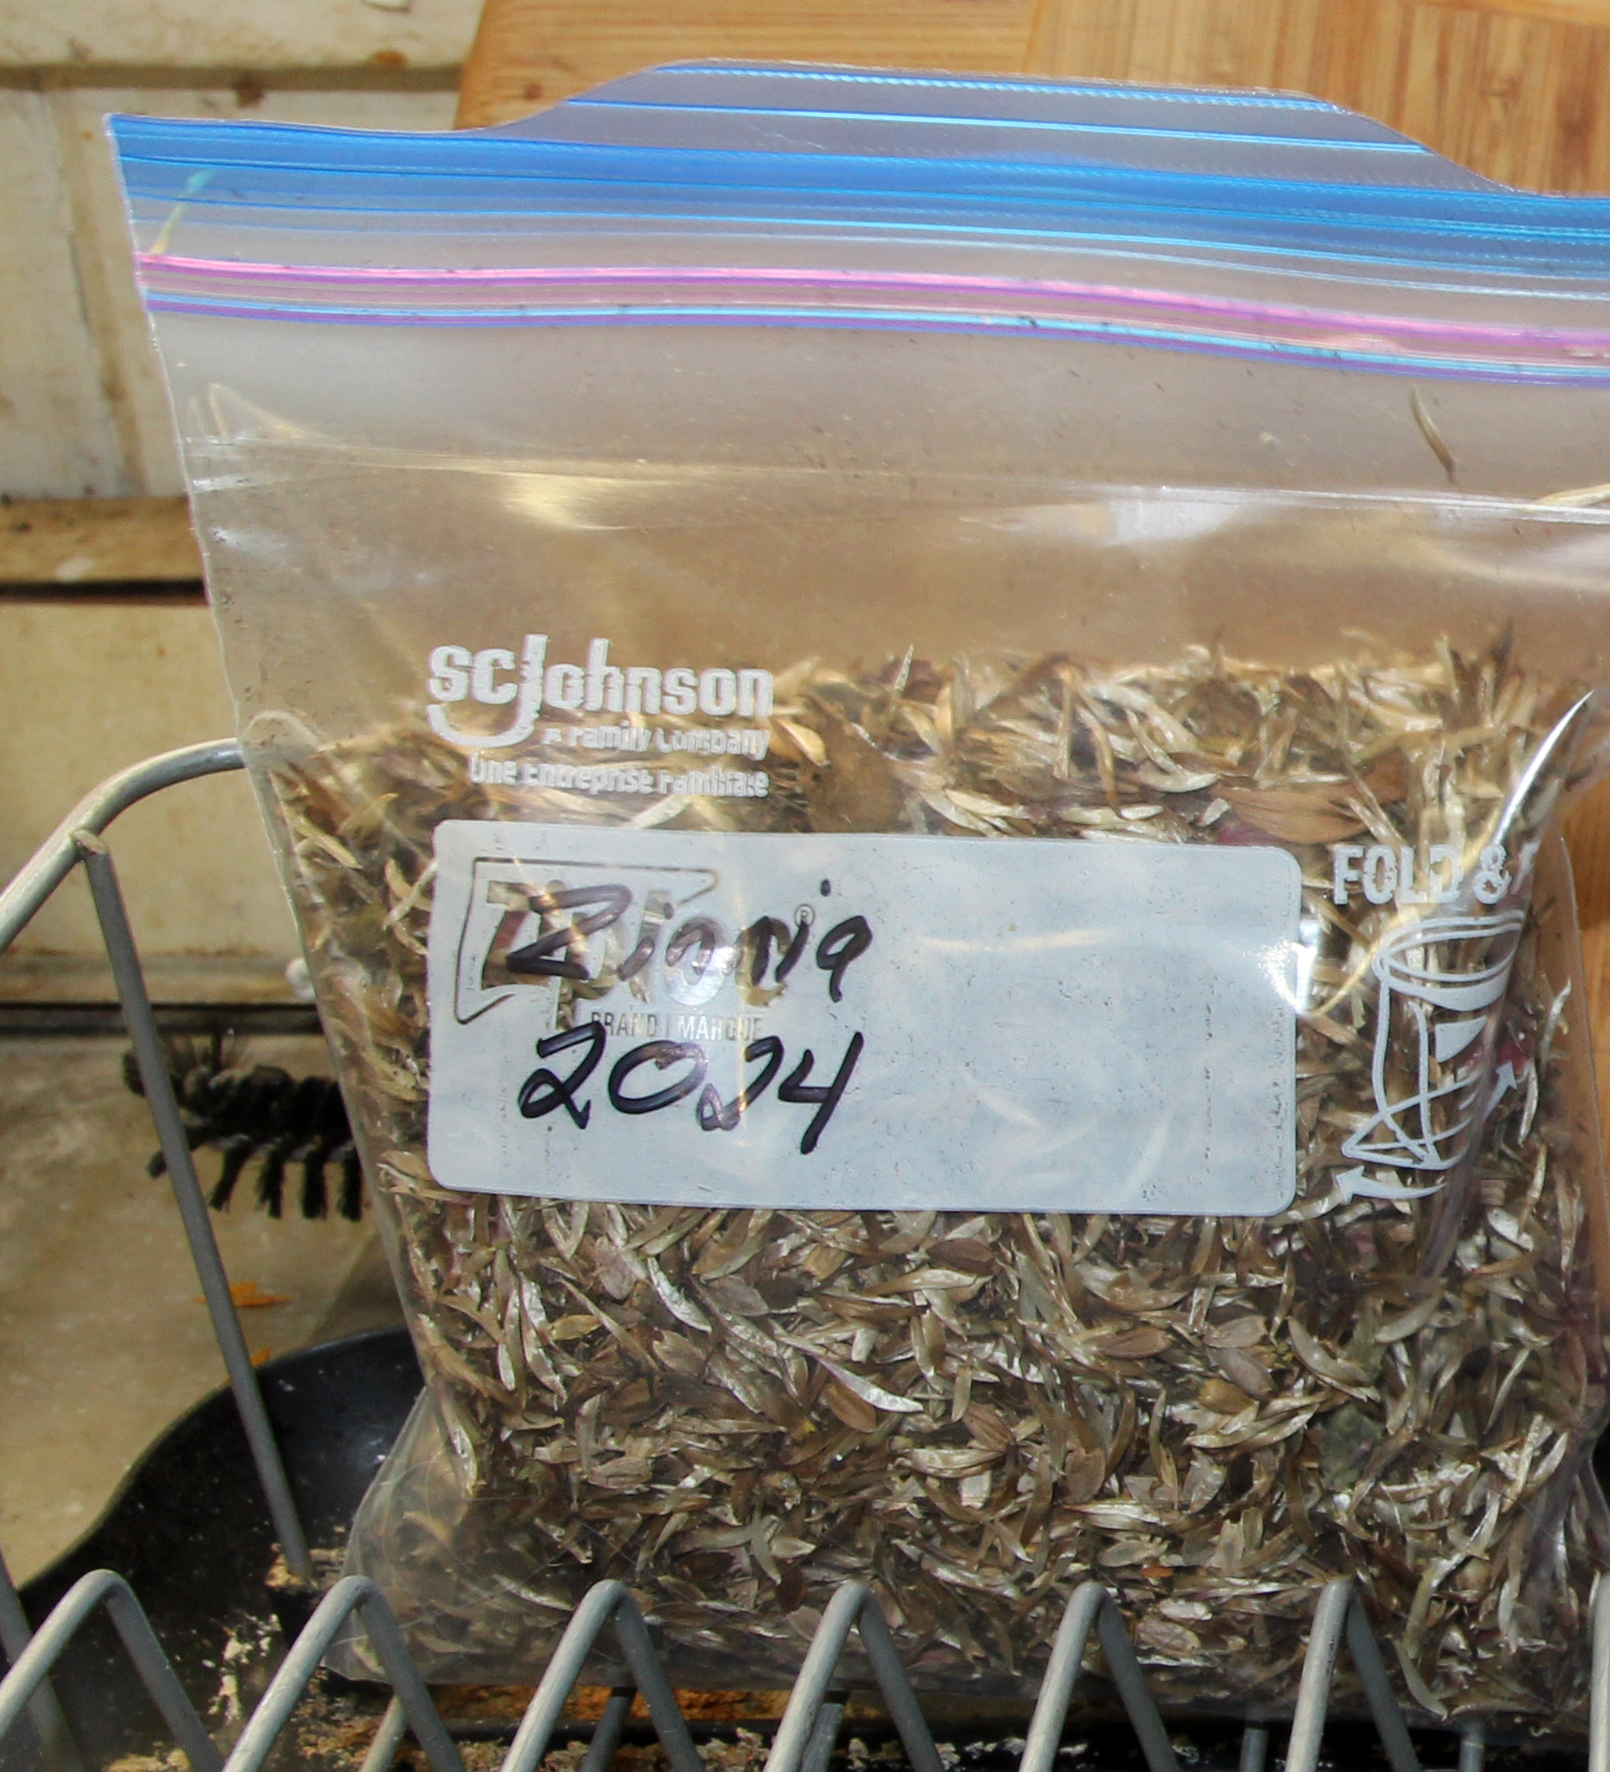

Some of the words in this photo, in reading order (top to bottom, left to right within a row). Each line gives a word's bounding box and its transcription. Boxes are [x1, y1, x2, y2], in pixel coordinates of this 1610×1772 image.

[1333, 844, 1465, 905] FOLD
[1475, 844, 1512, 904] &
[590, 1011, 657, 1037] BRAND
[676, 1012, 763, 1041] MARQUE
[518, 1020, 863, 1155] 2024
